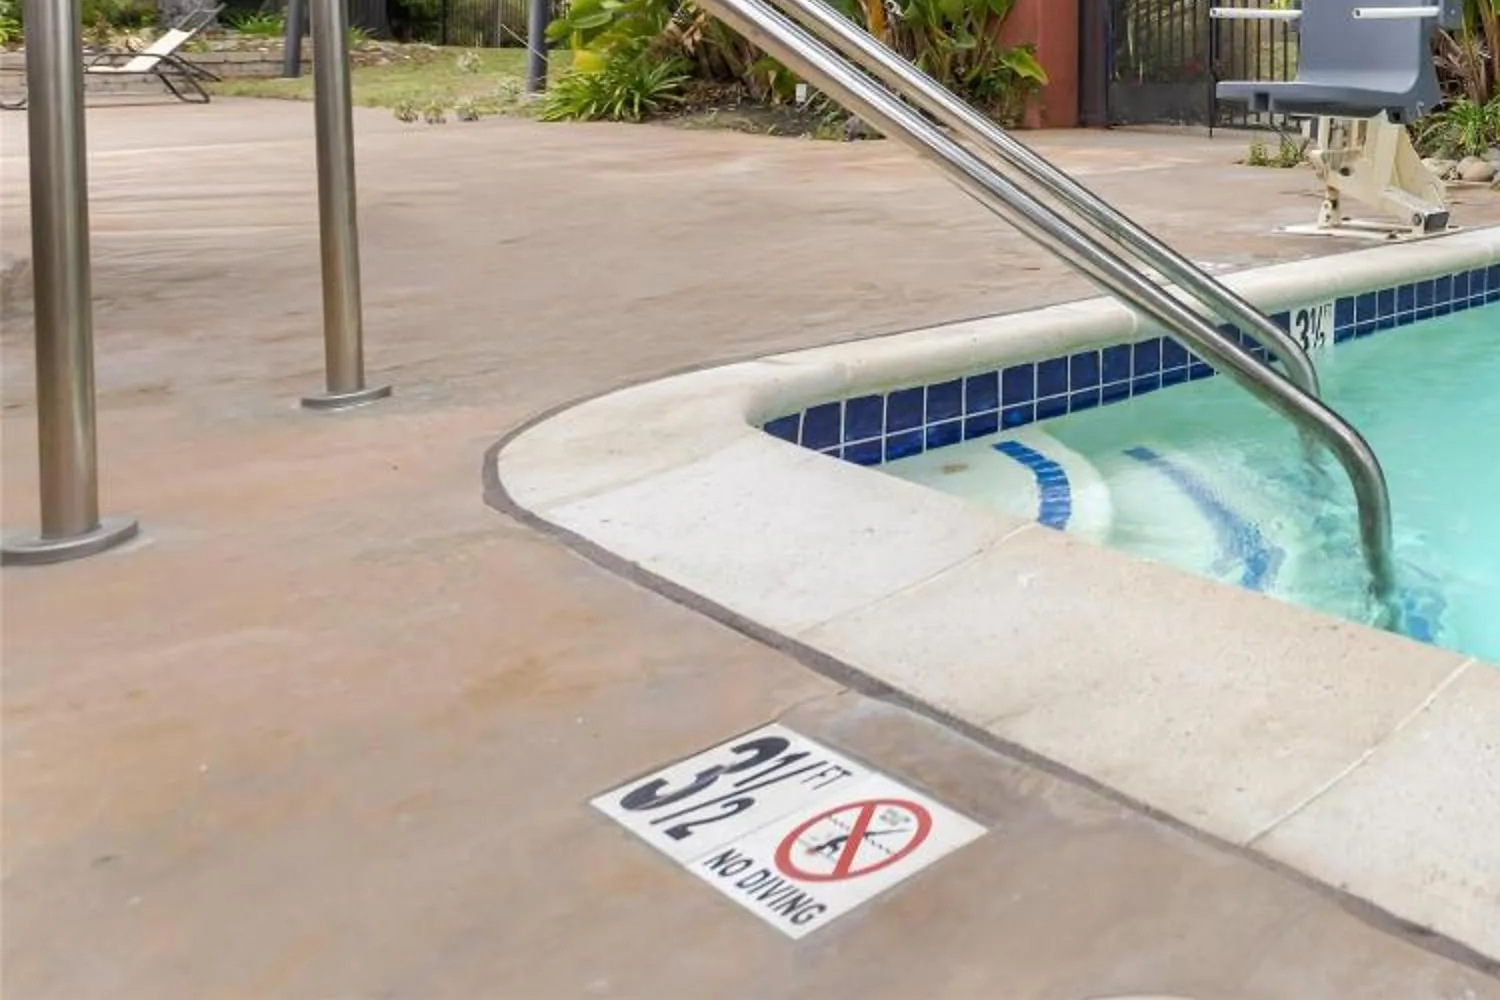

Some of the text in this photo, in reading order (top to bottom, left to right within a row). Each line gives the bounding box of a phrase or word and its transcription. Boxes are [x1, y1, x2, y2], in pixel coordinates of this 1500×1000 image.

[800, 765, 853, 790] FT
[703, 848, 827, 925] NO DIVING
